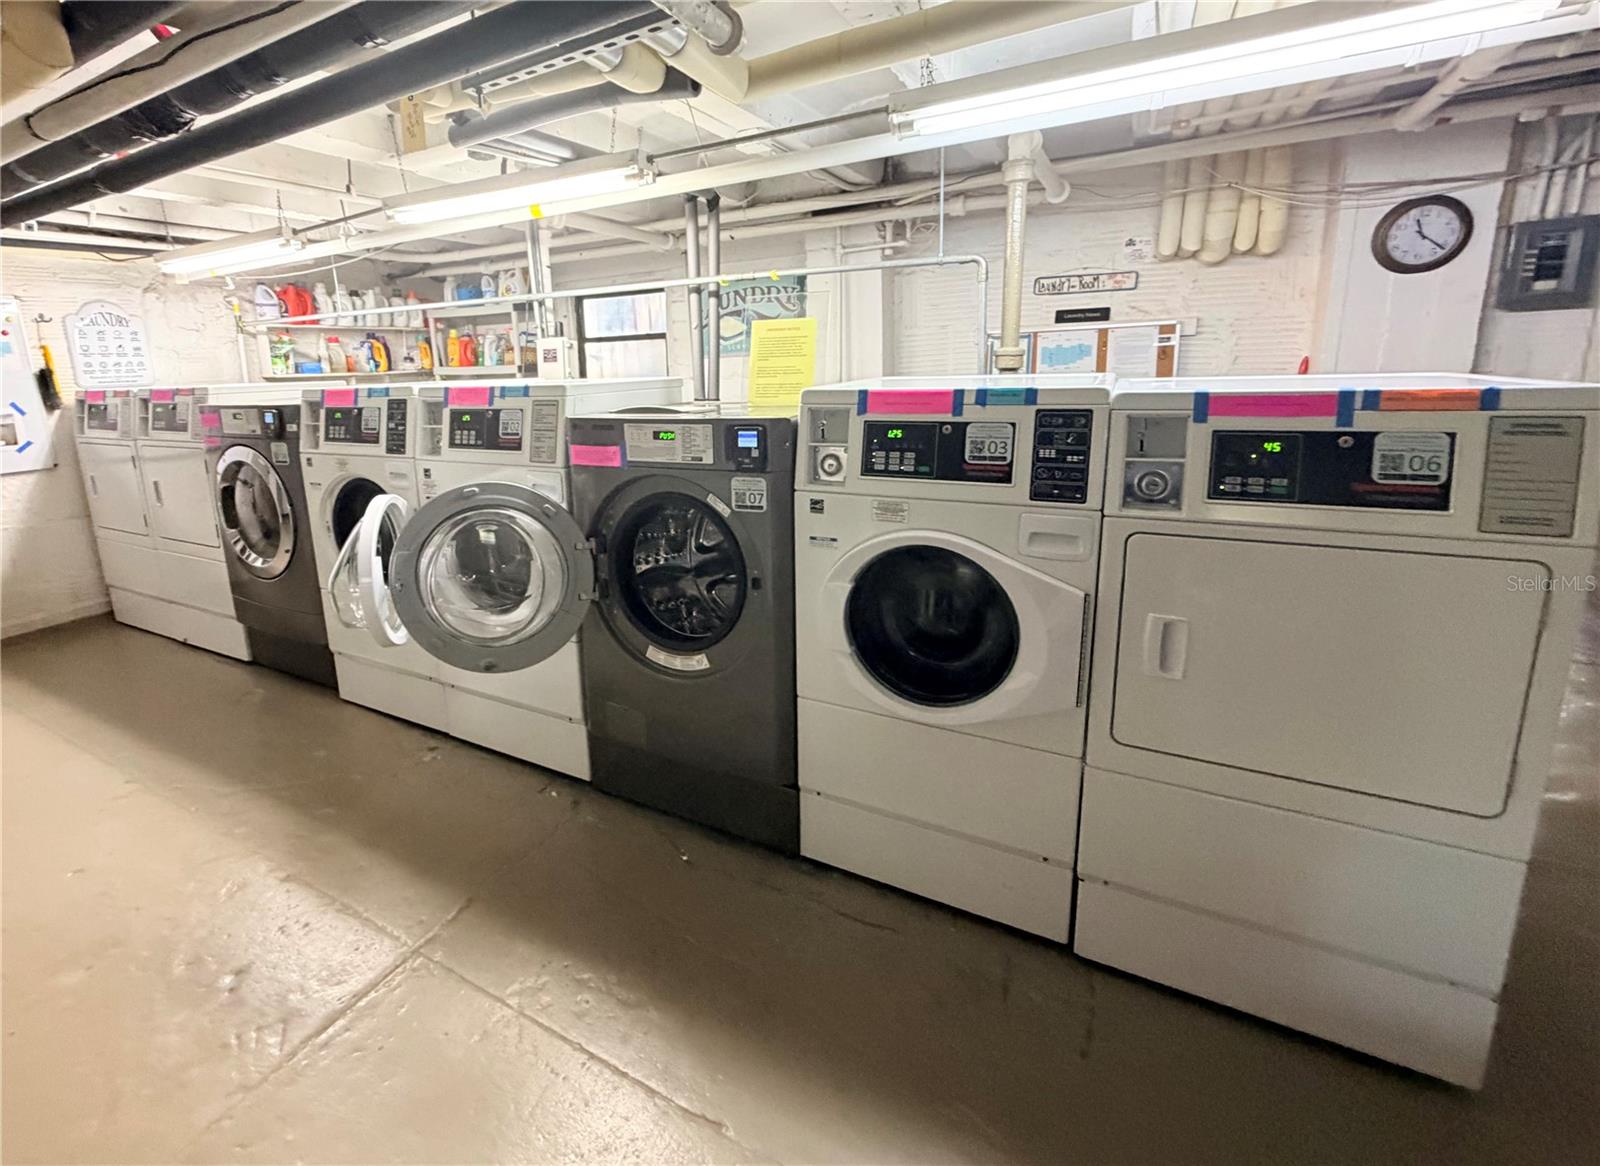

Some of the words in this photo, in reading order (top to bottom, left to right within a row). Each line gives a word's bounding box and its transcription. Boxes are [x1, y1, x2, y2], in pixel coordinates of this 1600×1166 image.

[987, 440, 1008, 455] 03
[1264, 443, 1281, 452] 45
[1408, 455, 1442, 472] 06
[748, 492, 765, 504] 07
